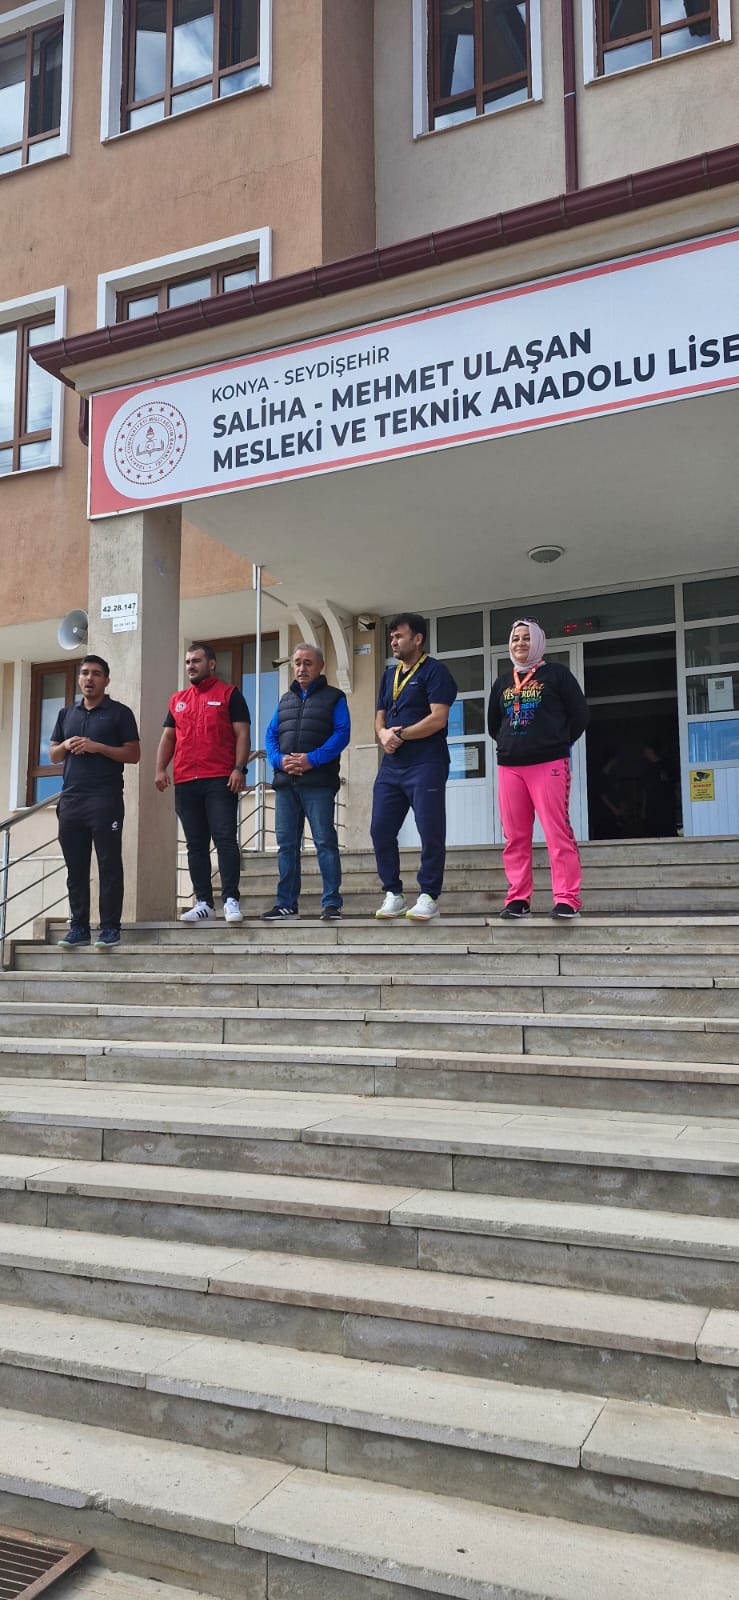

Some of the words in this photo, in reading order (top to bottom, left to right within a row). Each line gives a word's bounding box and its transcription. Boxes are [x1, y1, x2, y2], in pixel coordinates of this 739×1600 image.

[212, 376, 269, 403] KONYA
[284, 346, 390, 386] SEYDİŞEHİR
[213, 397, 307, 439] SALİHA
[332, 360, 454, 411] MEHMET
[463, 328, 592, 380] ULAŞAN
[213, 419, 322, 472] MESLEKİ
[331, 418, 367, 447] VE
[374, 388, 482, 438] TEKNİK
[490, 353, 656, 413] ANADOLU
[668, 333, 739, 376] LİSE
[103, 602, 136, 611] 42.28.147
